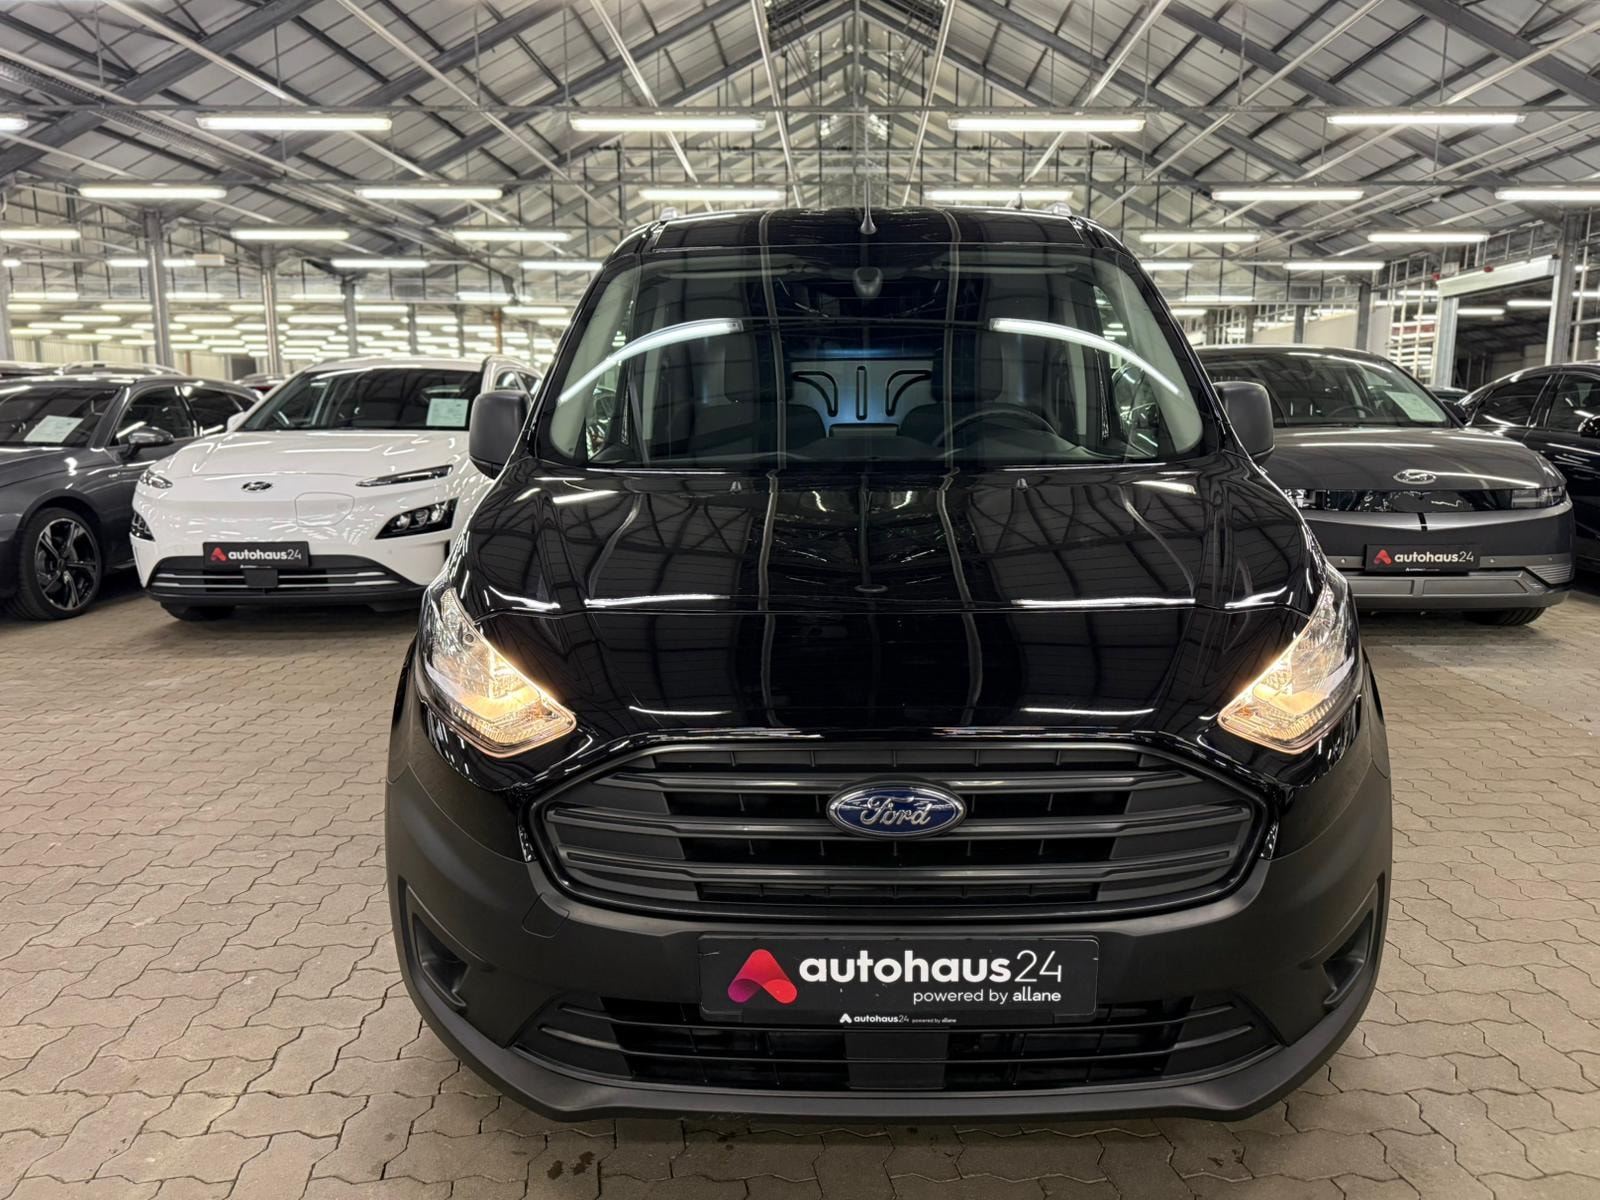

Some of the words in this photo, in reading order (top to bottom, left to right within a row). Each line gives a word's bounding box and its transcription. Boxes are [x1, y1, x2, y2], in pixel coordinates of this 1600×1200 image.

[228, 549, 302, 560] autohaus24
[1394, 551, 1474, 563] autohaus24
[859, 795, 932, 825] Ford
[799, 950, 1062, 983] autohaus24
[913, 988, 984, 1005] powered
[989, 988, 1009, 1005] by
[1012, 986, 1062, 1002] allane
[853, 1014, 910, 1024] autohaus24
